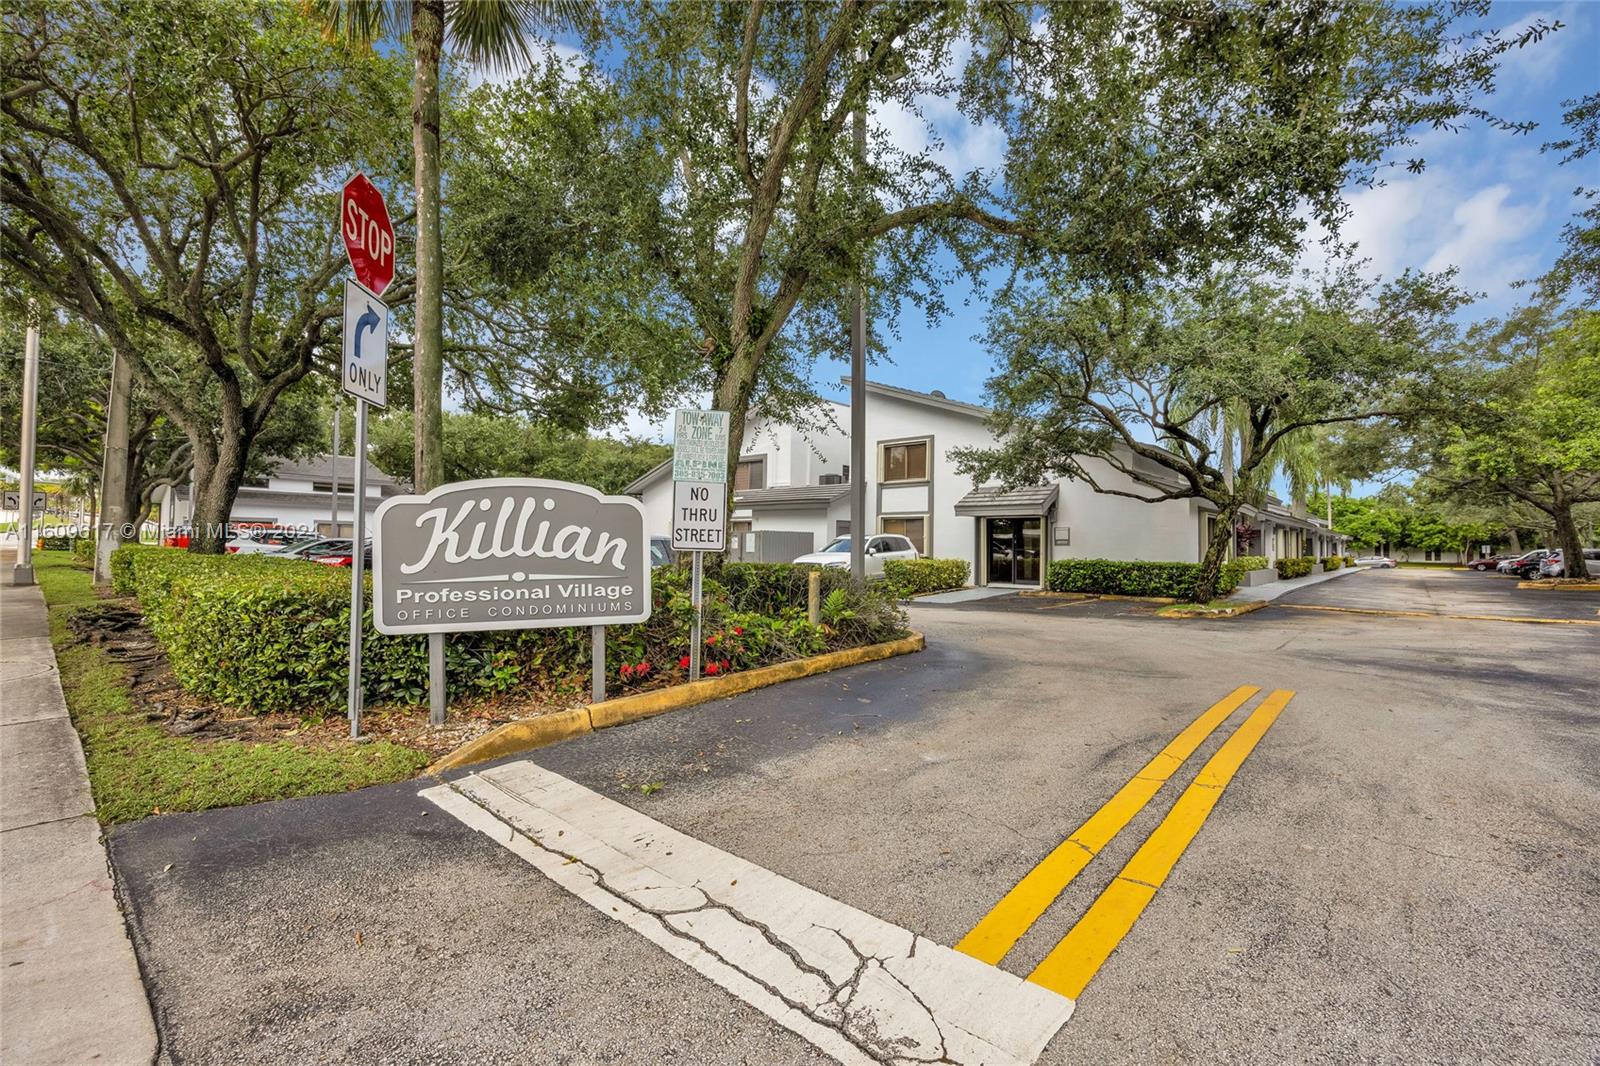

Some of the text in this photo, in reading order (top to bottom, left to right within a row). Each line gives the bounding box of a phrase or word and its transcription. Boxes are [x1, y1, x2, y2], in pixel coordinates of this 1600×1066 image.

[346, 198, 392, 267] STOP
[350, 362, 382, 394] ONLY
[691, 426, 713, 440] ZONE
[690, 487, 709, 501] NO
[681, 507, 717, 522] THRU
[400, 496, 628, 575] Killian
[675, 528, 722, 543] STREET
[396, 583, 633, 604] Professional Village
[397, 601, 633, 621] OFFICE CONDOMINIUMS
